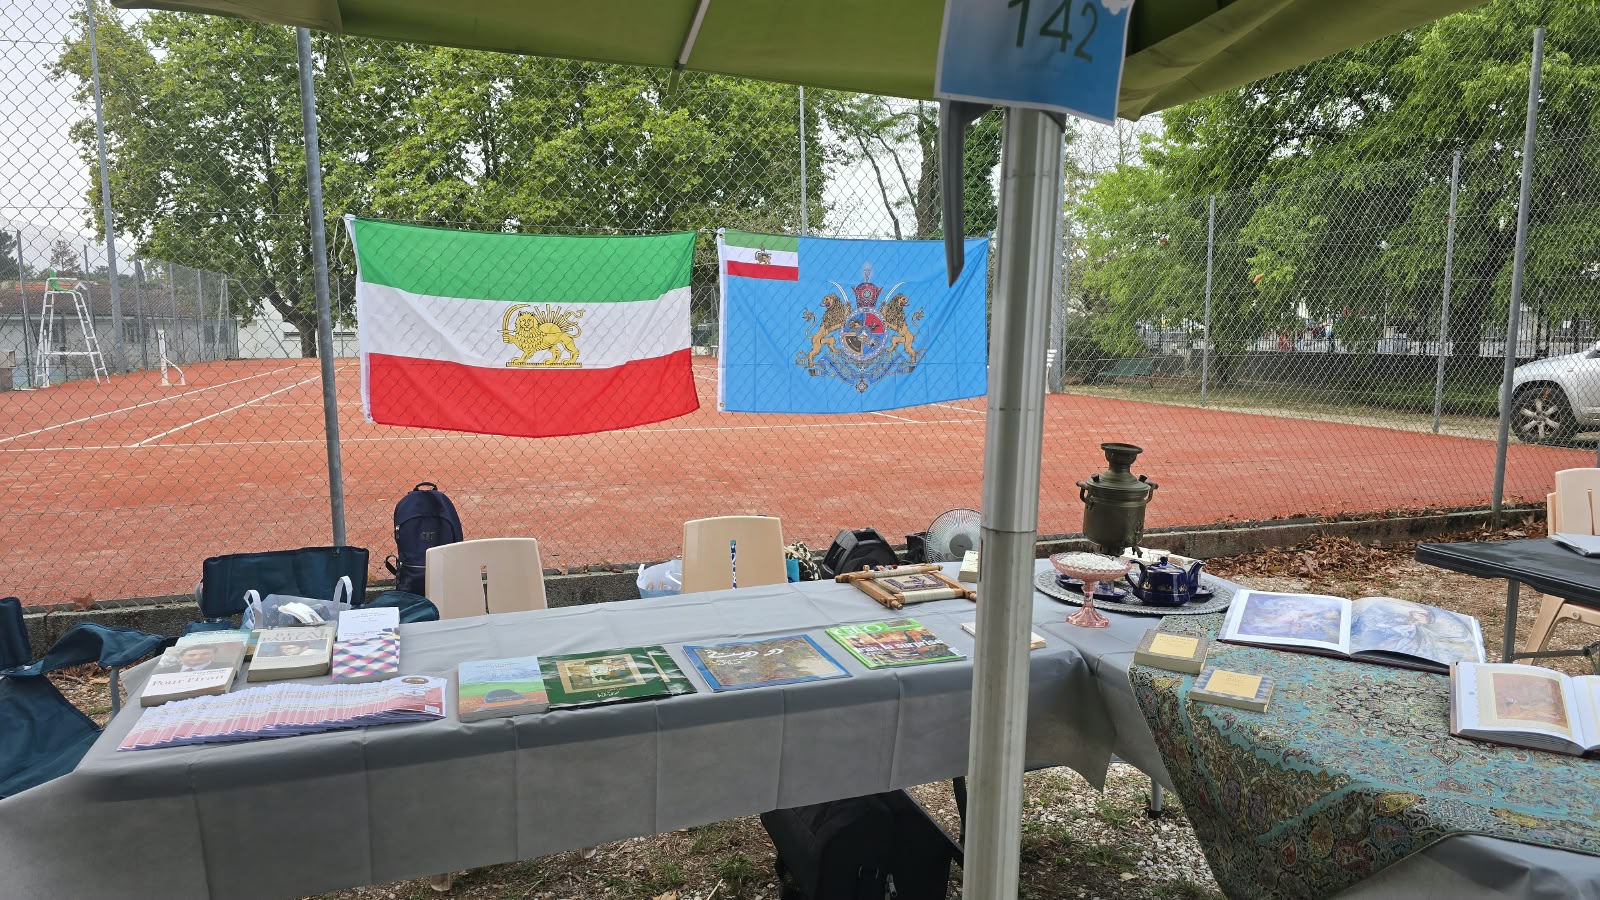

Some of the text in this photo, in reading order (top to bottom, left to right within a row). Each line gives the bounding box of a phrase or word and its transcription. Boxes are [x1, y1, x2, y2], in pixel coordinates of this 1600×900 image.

[1007, 0, 1097, 63] 142
[834, 624, 882, 635] GEO
[895, 638, 944, 650] surprise
